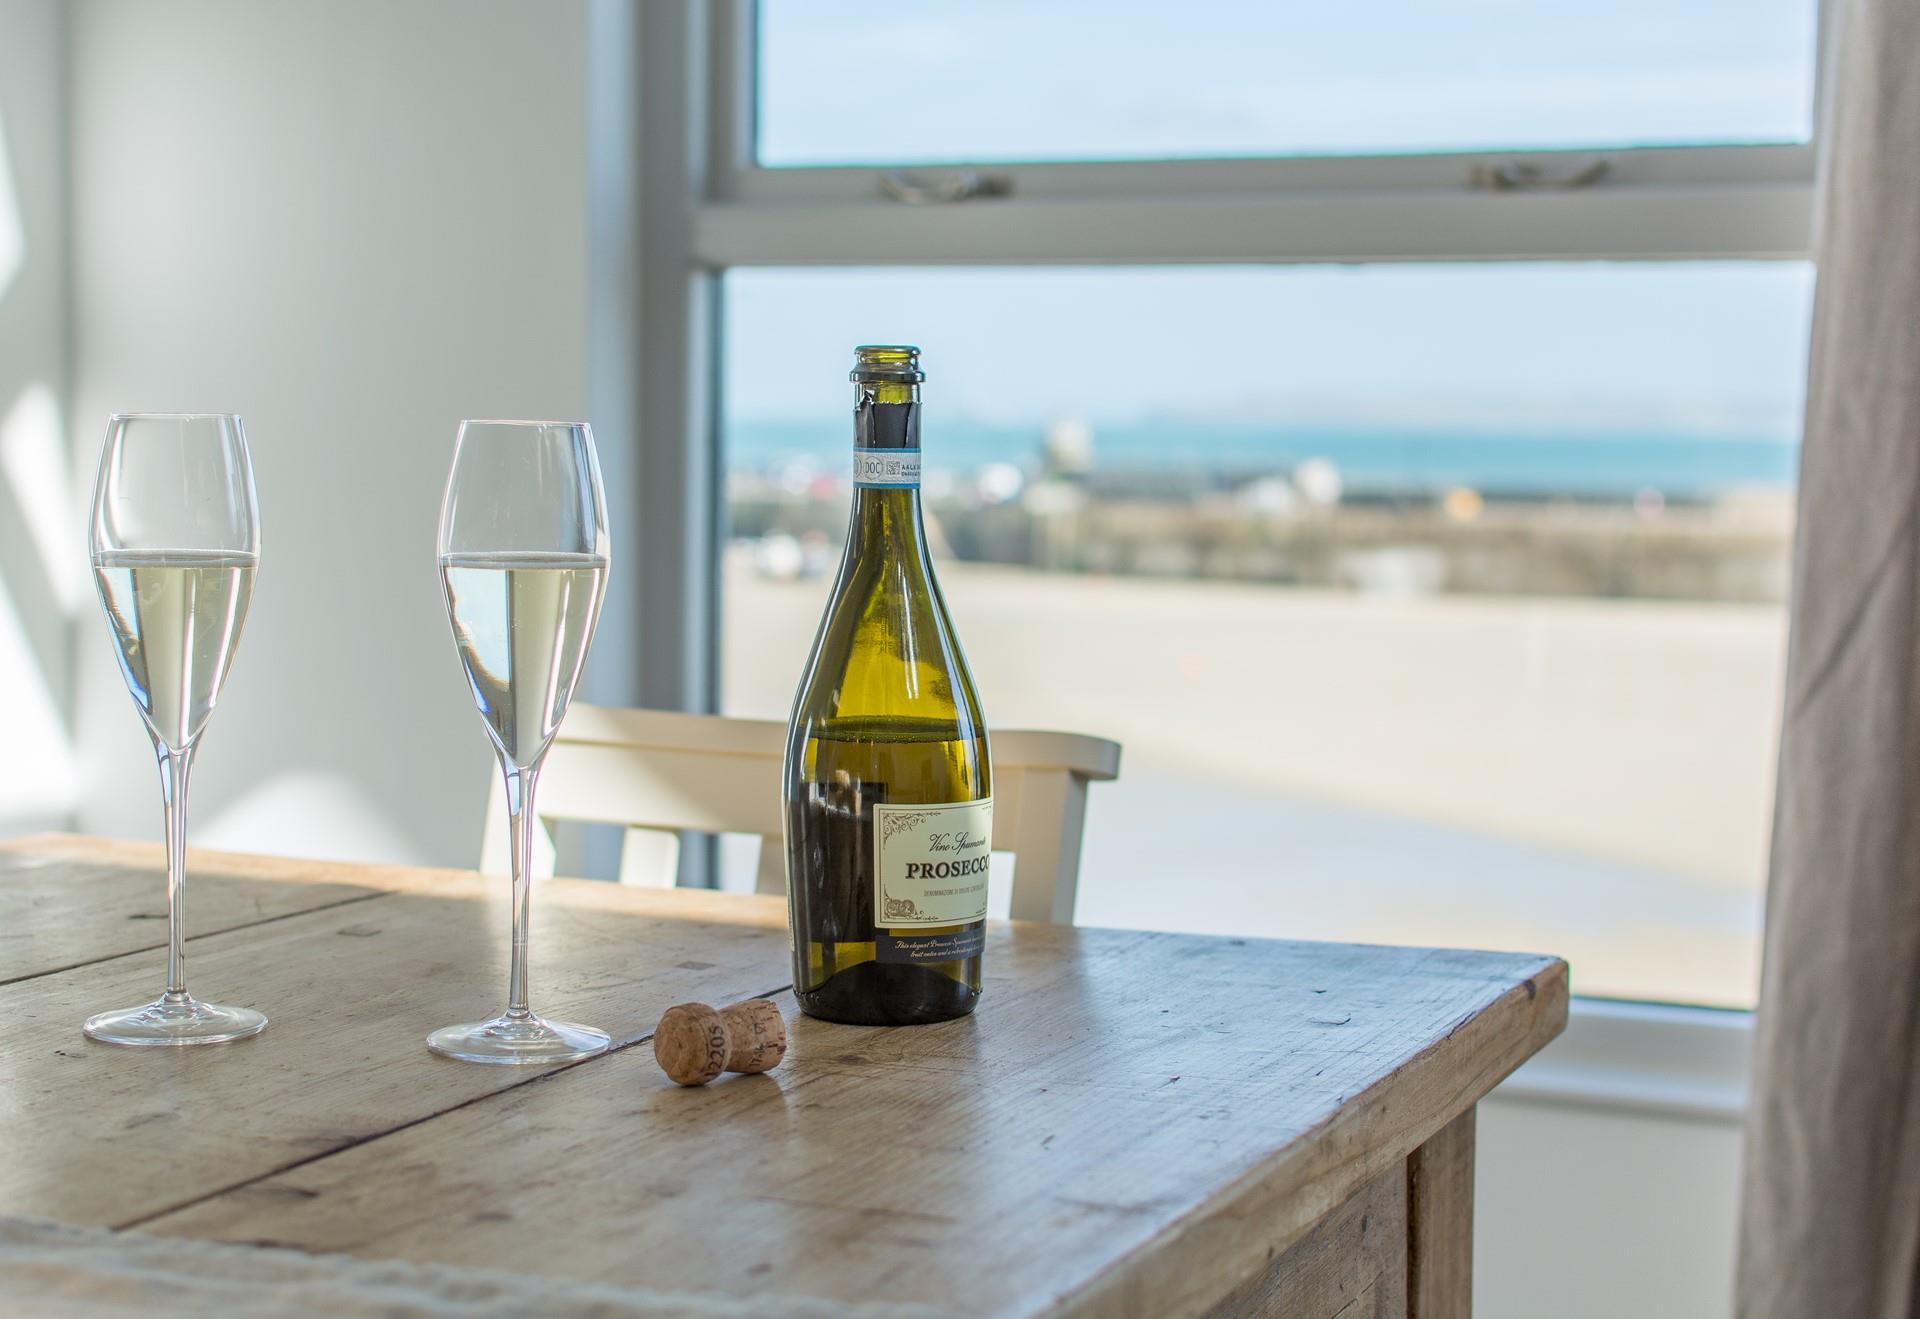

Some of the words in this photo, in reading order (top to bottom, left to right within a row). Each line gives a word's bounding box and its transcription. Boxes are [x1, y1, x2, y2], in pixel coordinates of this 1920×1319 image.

[866, 462, 880, 474] DOC
[929, 832, 950, 852] Vino
[895, 940, 908, 949] This
